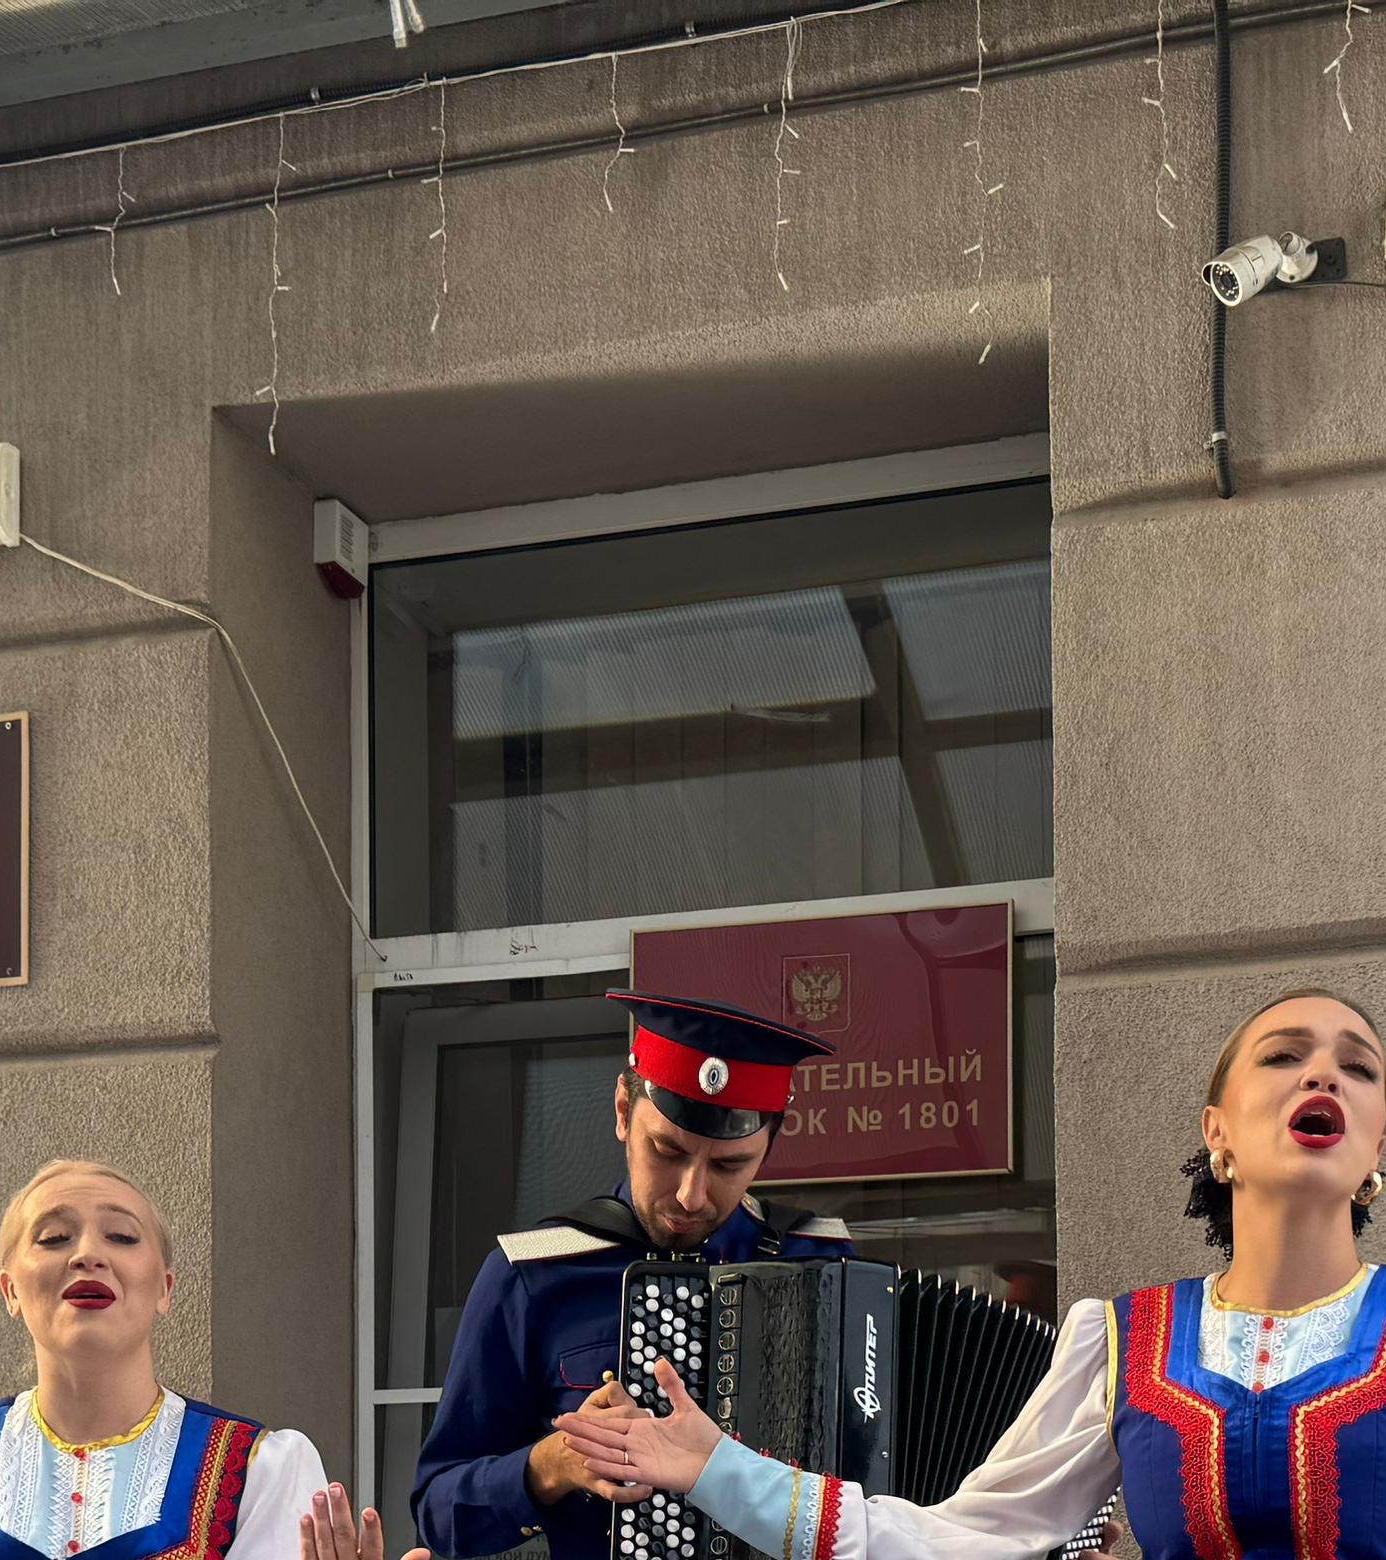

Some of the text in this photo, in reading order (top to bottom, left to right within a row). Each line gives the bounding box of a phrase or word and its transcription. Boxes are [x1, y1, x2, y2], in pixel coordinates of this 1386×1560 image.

[790, 1048, 982, 1093] ТЕЛЬНЫЙ
[847, 1105, 882, 1133] №
[898, 1099, 979, 1130] 1801
